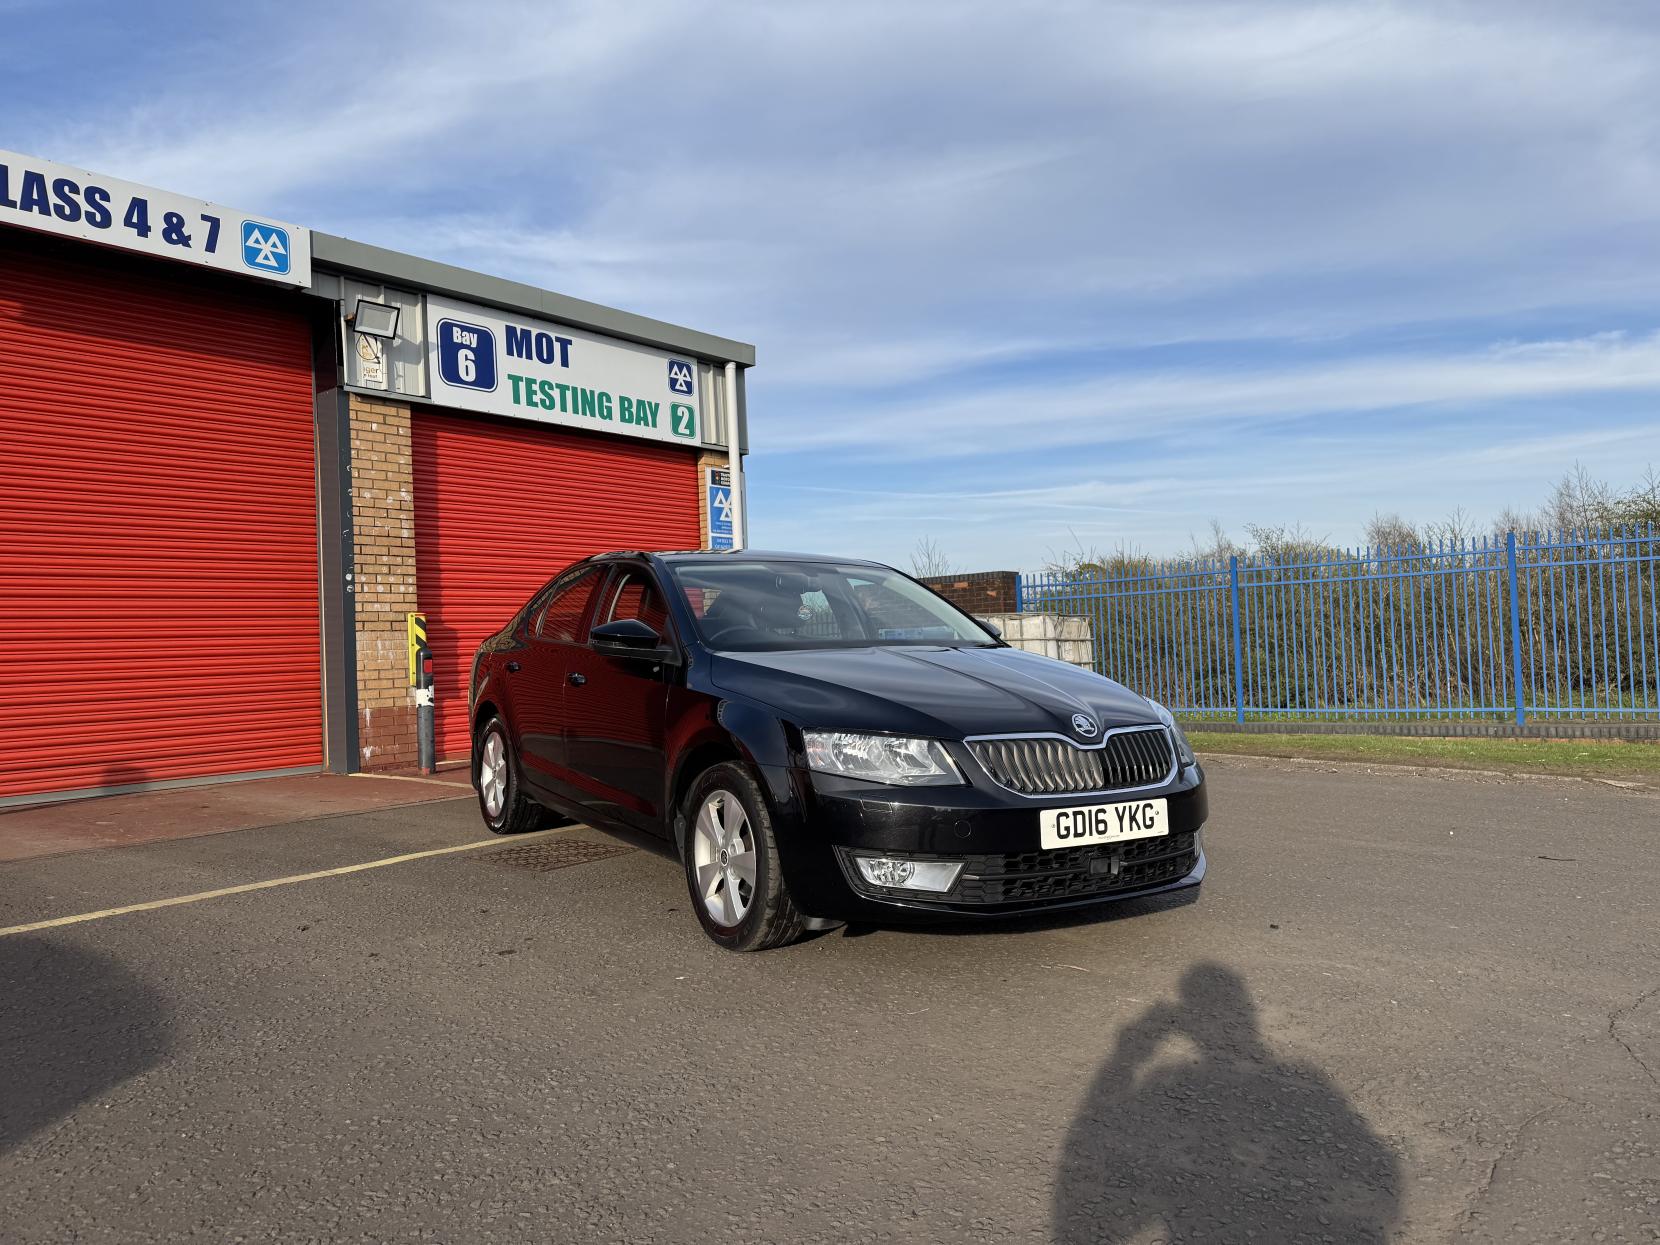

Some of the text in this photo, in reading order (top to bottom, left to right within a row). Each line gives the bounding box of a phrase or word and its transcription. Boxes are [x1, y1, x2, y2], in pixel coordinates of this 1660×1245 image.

[123, 196, 152, 239] 4
[161, 211, 193, 249] &
[200, 213, 221, 254] 7
[452, 326, 478, 347] Bay
[504, 324, 573, 369] MOT
[457, 348, 476, 382] 6
[507, 373, 660, 429] TESTING BAY
[677, 406, 690, 435] 2
[1056, 802, 1155, 840] GD16 YKG
